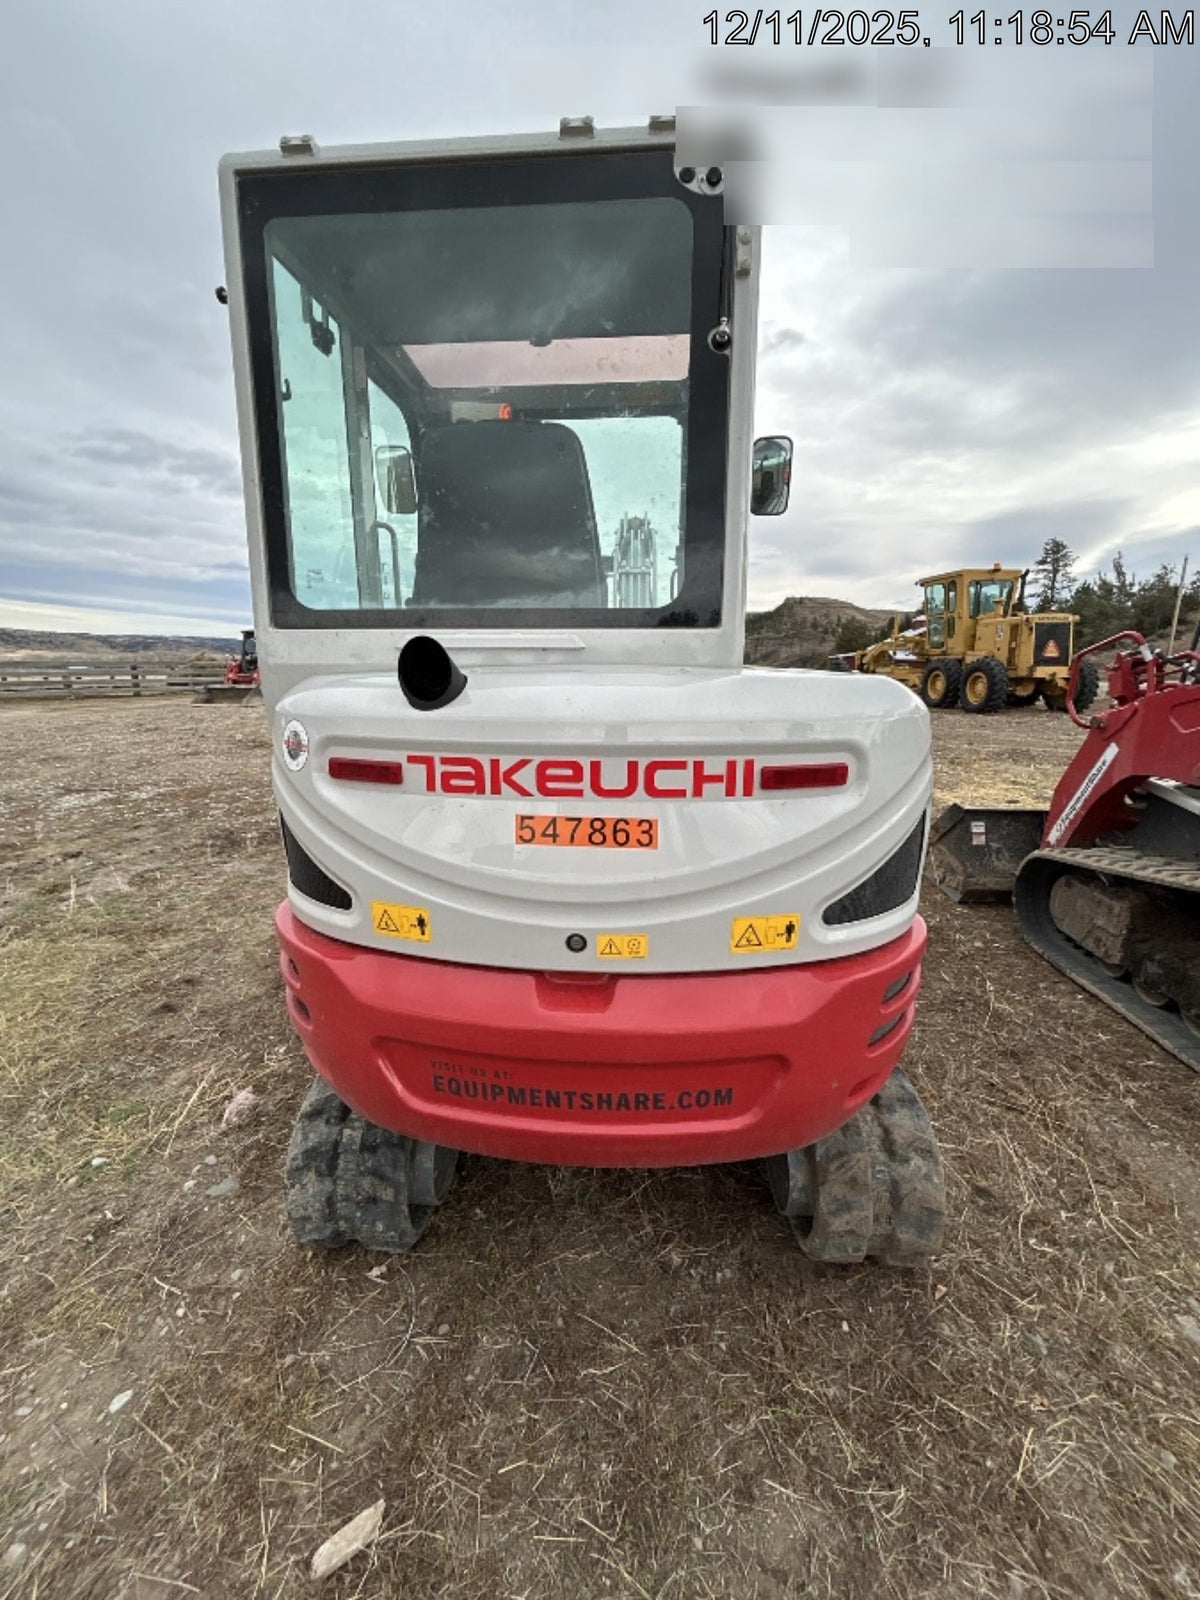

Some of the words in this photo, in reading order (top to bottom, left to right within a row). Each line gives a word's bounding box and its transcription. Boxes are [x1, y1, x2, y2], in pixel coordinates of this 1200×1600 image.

[518, 815, 654, 847] 547863
[430, 1059, 463, 1074] VISIT
[470, 1066, 487, 1077] US
[432, 1073, 734, 1111] EQUIPMENTSHARE.COM
